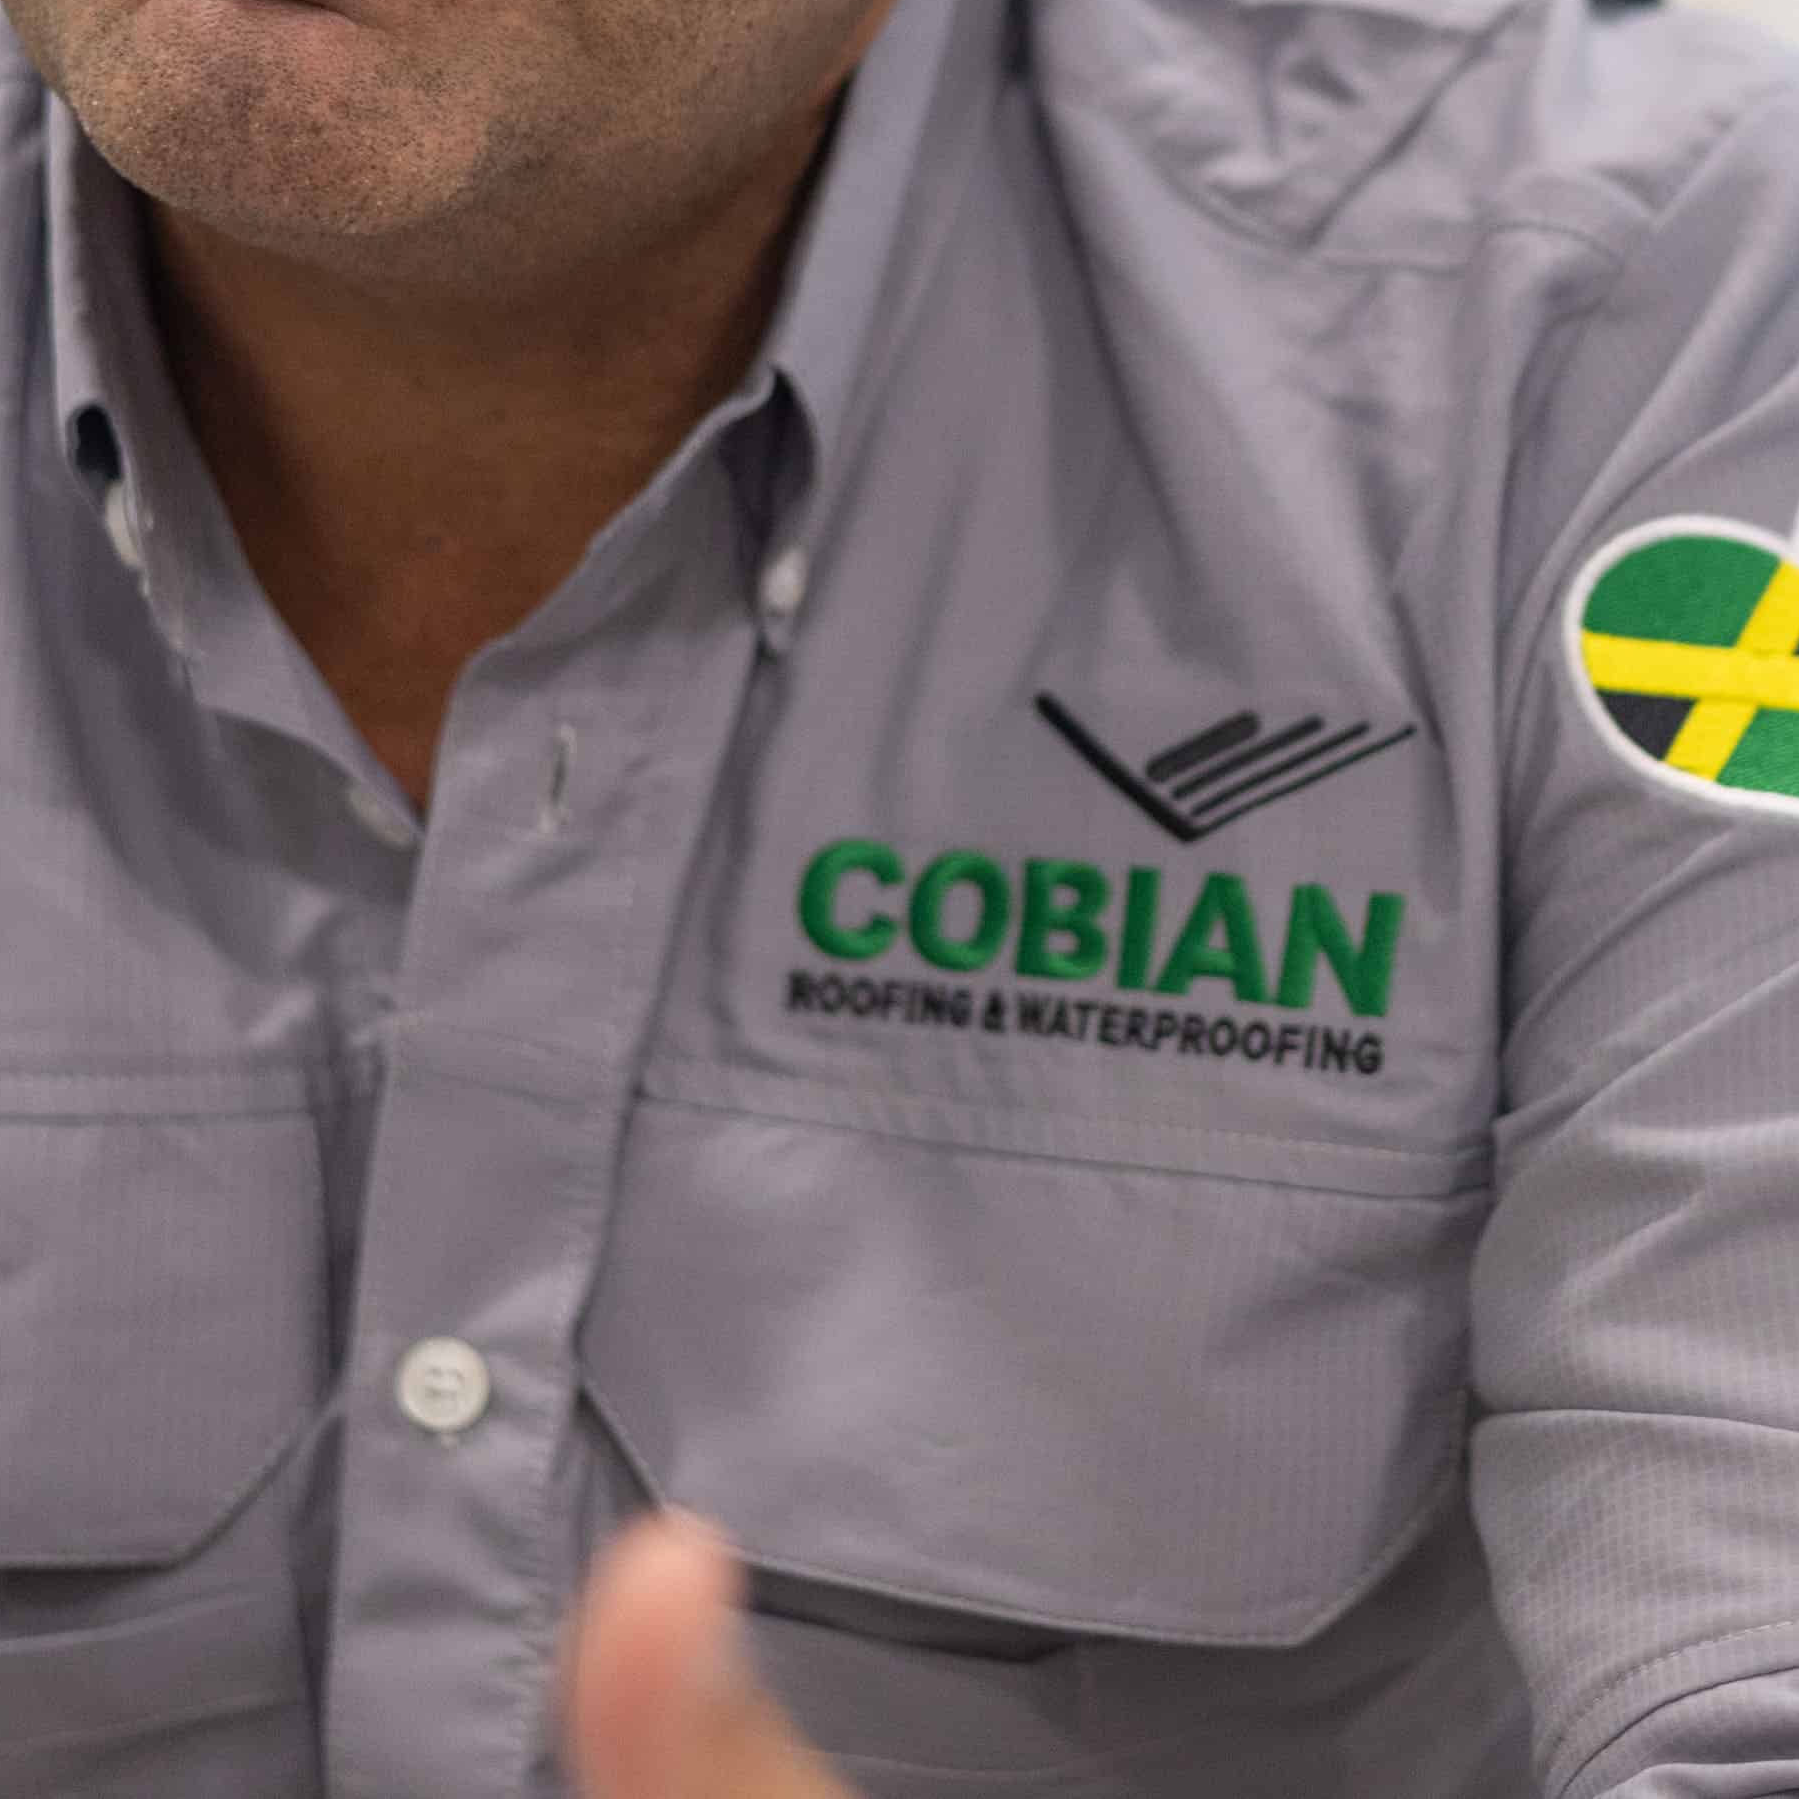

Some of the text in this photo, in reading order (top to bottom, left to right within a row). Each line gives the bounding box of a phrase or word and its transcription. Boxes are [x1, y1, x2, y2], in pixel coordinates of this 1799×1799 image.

[797, 839, 1405, 1016] COBIAN
[787, 971, 1383, 1074] ROOFING & WATERPROOFING
